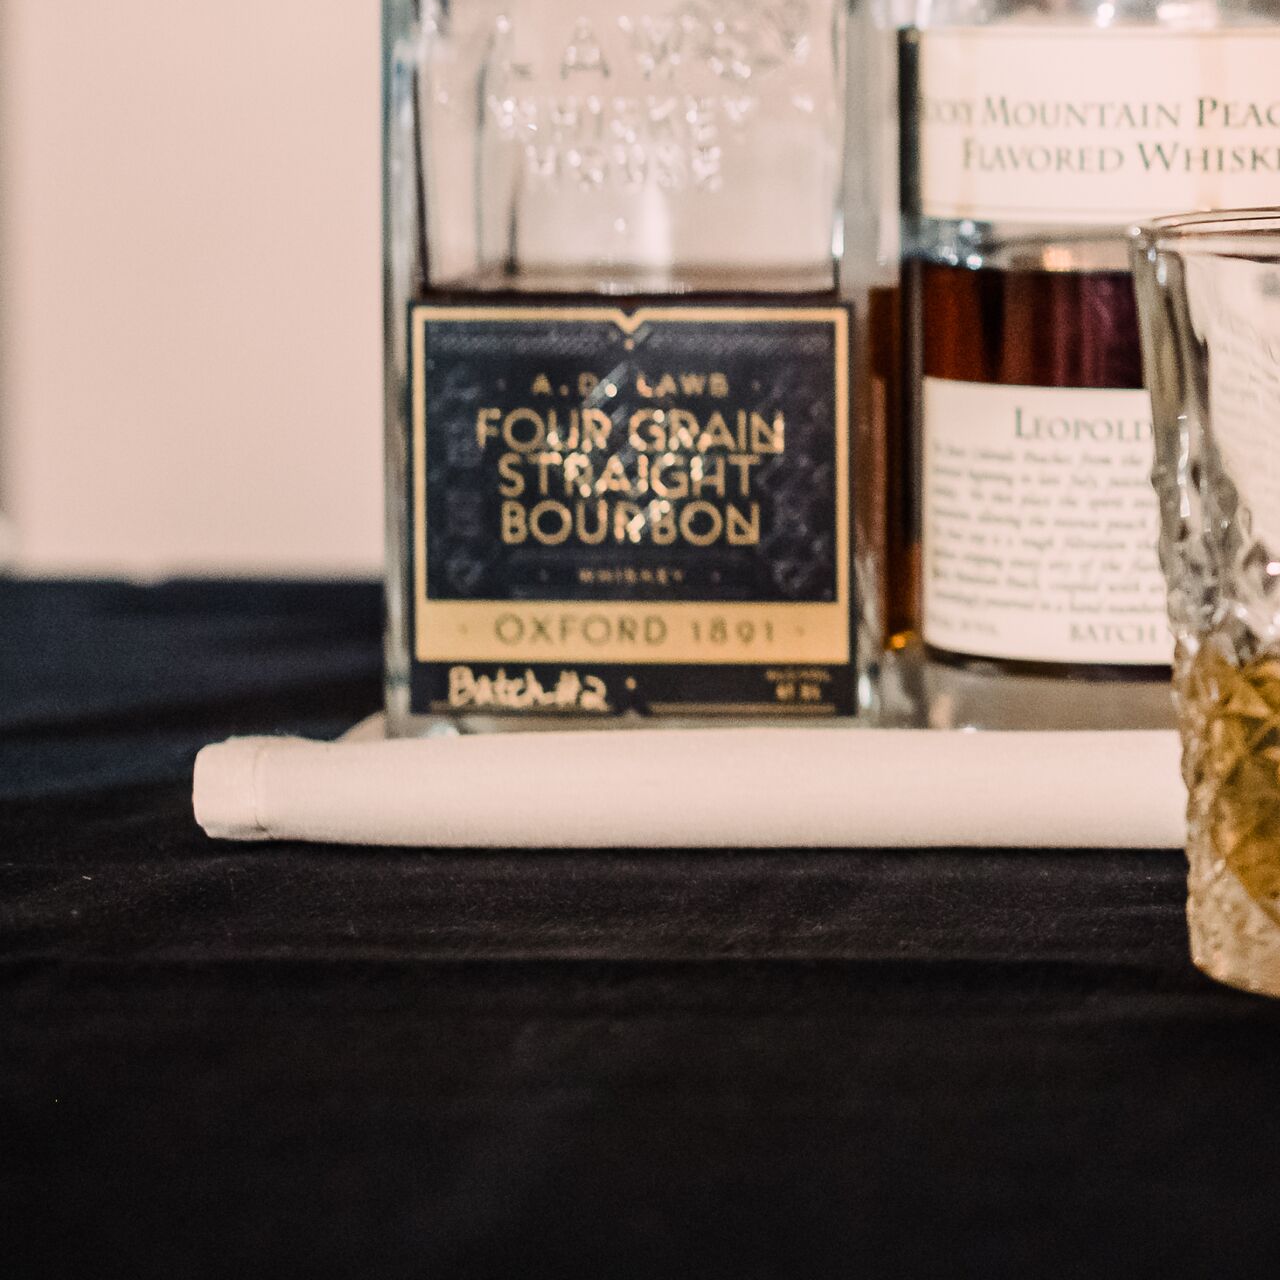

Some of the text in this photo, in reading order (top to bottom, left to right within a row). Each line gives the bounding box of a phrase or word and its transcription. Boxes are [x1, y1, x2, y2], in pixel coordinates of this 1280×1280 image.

[980, 96, 1182, 130] MOUNTAIN
[960, 137, 1124, 174] FLAVORED
[476, 407, 785, 454] FOUR GRAIN
[498, 451, 760, 500] STRAIGHT
[501, 499, 762, 547] BOURBON
[493, 613, 777, 647] OXFORD 1891
[1068, 623, 1160, 643] BATCH
